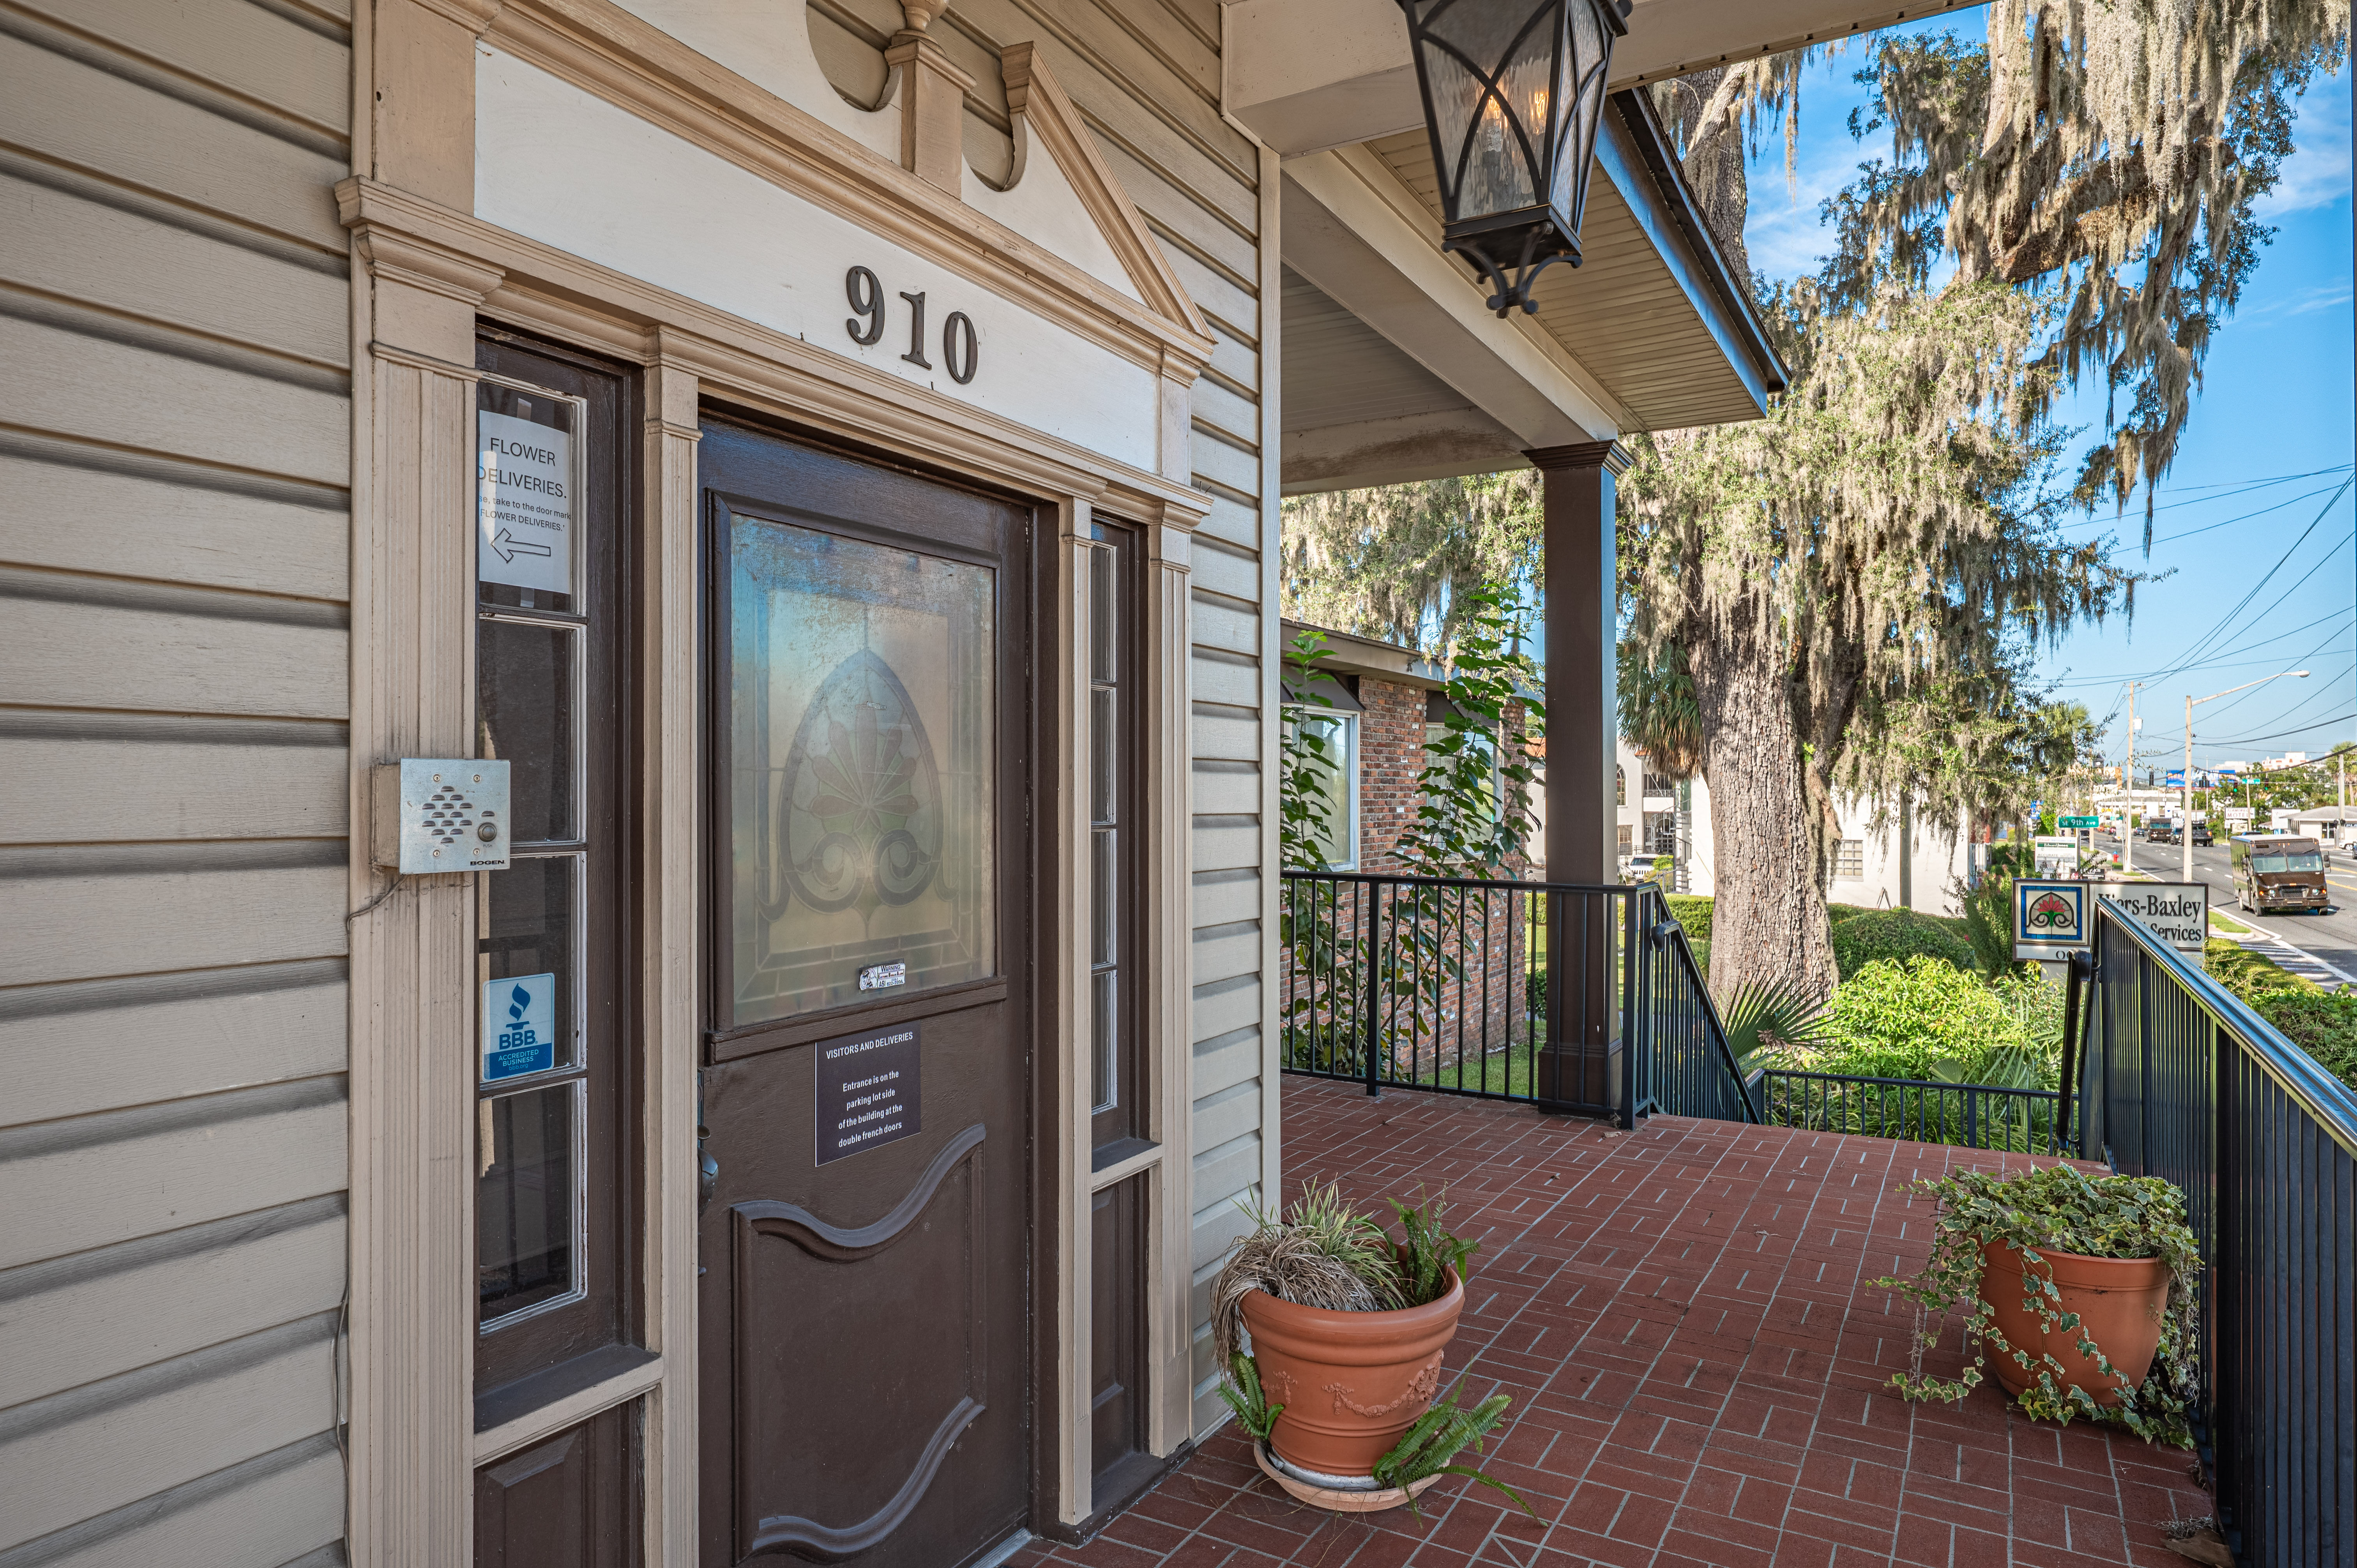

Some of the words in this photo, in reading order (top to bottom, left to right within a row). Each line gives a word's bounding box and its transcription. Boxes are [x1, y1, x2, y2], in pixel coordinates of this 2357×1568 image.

[846, 265, 978, 385] 910
[491, 437, 555, 466] FLOWER
[479, 466, 567, 498] DELIVERIES.
[480, 509, 516, 523] FLOWER
[493, 497, 511, 507] take
[522, 503, 535, 512] the
[536, 506, 553, 516] door
[499, 1029, 536, 1050] BBB
[826, 1044, 859, 1059] VISITORS
[860, 1040, 874, 1052] AND
[875, 1031, 913, 1048] DELIVERIES
[498, 1049, 539, 1062] ACCREDITED
[503, 1056, 534, 1067] BUSINESS
[843, 1077, 872, 1092] Entrance
[873, 1075, 879, 1084] is
[880, 1074, 888, 1082] on
[889, 1070, 899, 1080] the
[846, 1095, 871, 1111] parking
[873, 1092, 881, 1102] lot
[882, 1088, 895, 1099] side
[839, 1119, 845, 1129] of
[846, 1118, 857, 1127] the
[858, 1109, 884, 1124] building
[885, 1106, 892, 1115] at
[892, 1104, 903, 1114] the
[839, 1133, 861, 1148] double
[862, 1126, 883, 1140] french
[884, 1121, 902, 1133] doors
